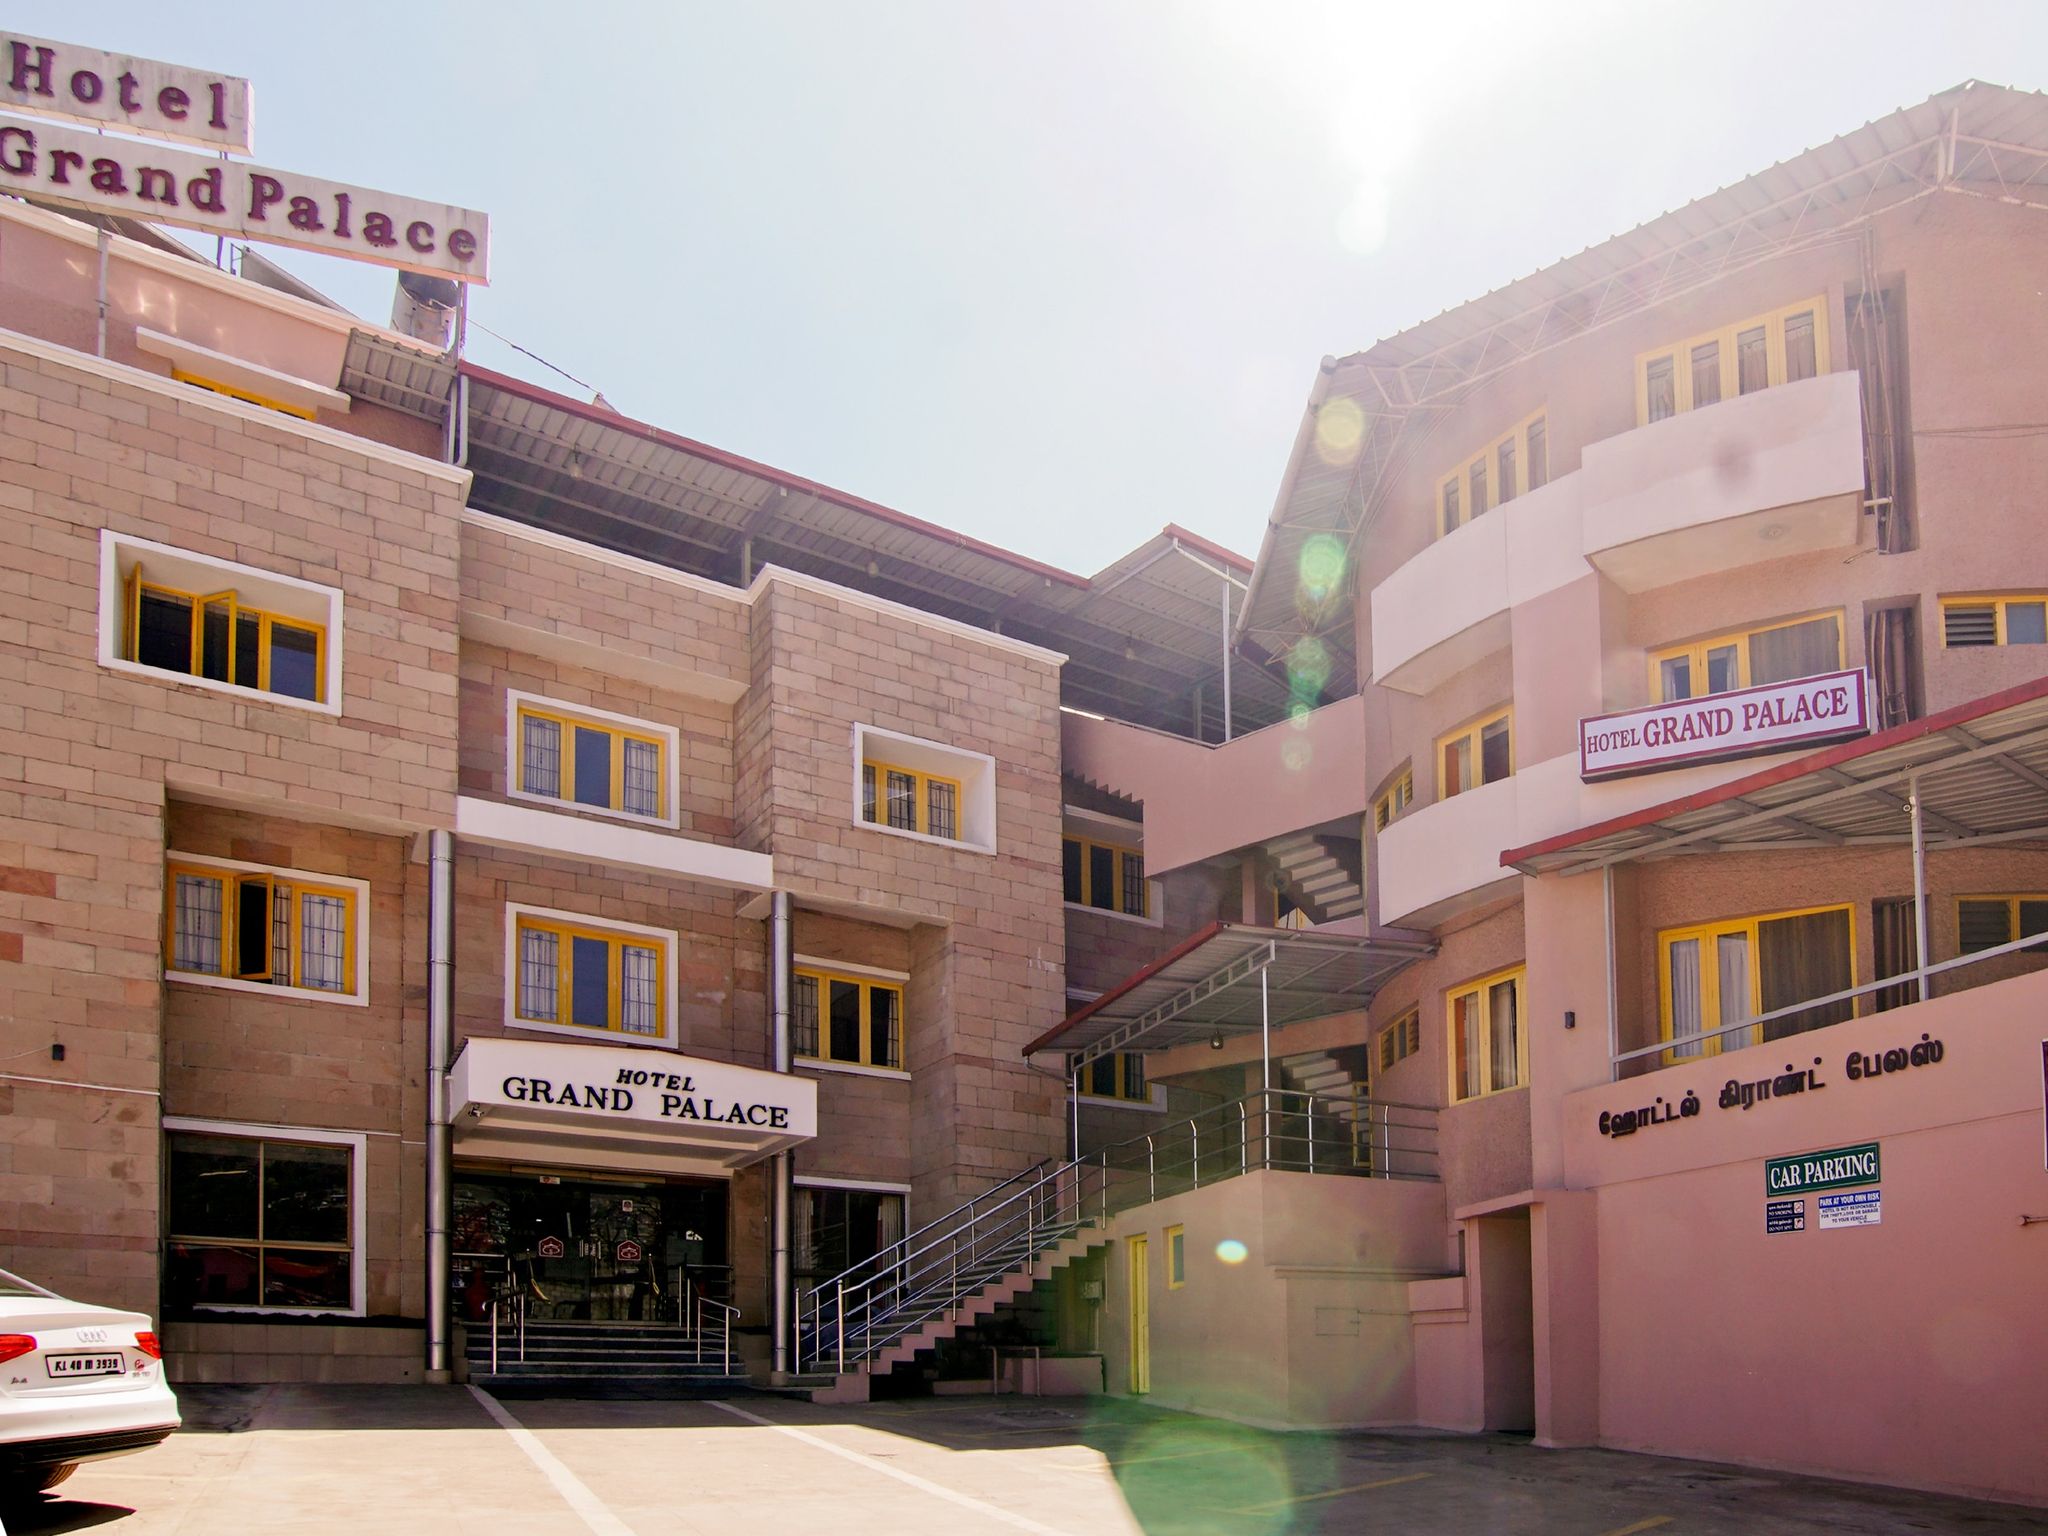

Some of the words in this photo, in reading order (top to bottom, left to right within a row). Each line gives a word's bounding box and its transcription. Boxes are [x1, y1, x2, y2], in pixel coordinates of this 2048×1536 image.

[8, 40, 229, 131] Hotel
[0, 126, 226, 214] Grand
[247, 173, 477, 263] Palace
[1586, 728, 1641, 754] HOTEL
[1642, 707, 1734, 748] GRAND
[1742, 686, 1849, 732] PALACE
[502, 1076, 634, 1112] GRAND
[660, 1093, 789, 1129] PALACE
[615, 1068, 696, 1093] HOTEL
[1598, 1089, 1701, 1139] ஹோட்டல்
[1845, 1033, 1945, 1081] பேலஸ்
[1770, 1164, 1802, 1189] CAR
[1803, 1151, 1876, 1184] PARKING
[1820, 1198, 1833, 1207] PARK
[1833, 1197, 1840, 1205] AT
[1840, 1195, 1855, 1204] YOUR
[1855, 1193, 1867, 1202] OWN
[1867, 1192, 1880, 1201] RISK
[55, 1360, 67, 1371] KL
[96, 1358, 118, 1369] 3939
